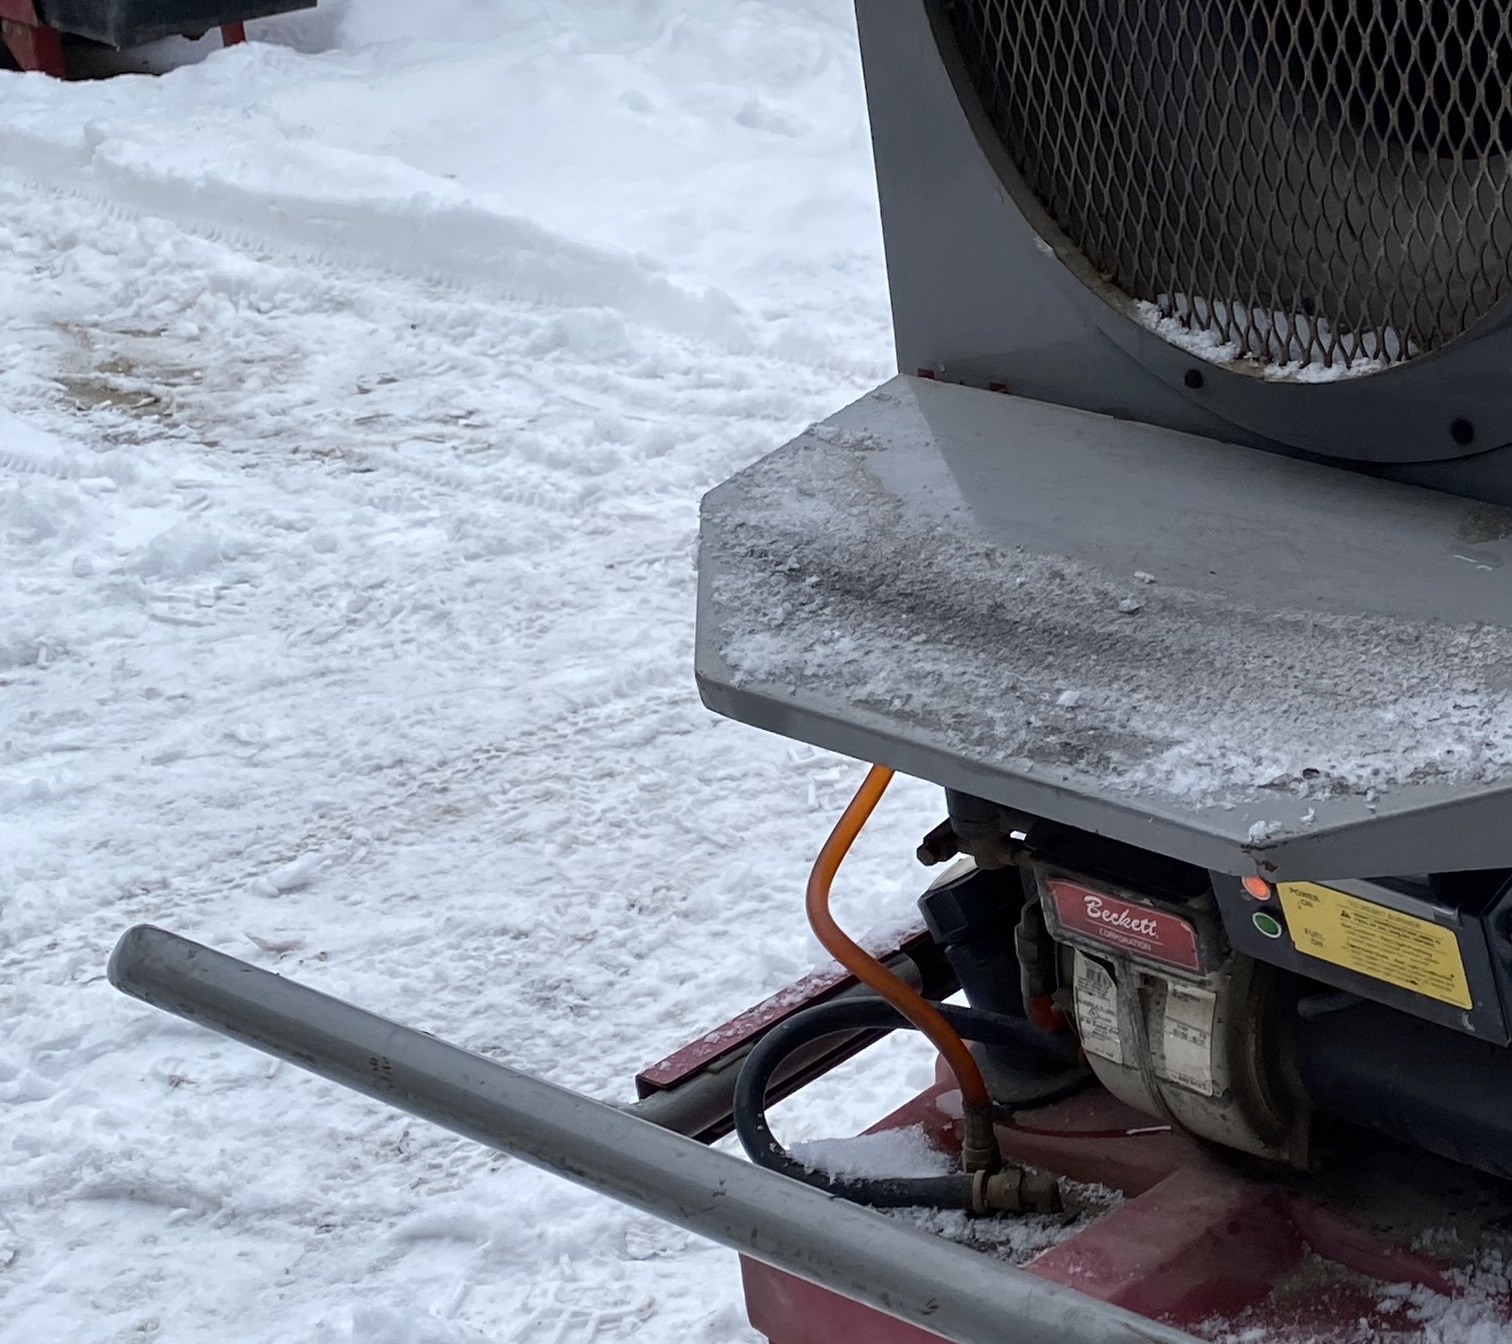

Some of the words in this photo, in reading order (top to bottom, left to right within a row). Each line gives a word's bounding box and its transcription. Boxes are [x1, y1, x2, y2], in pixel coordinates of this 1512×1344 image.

[1289, 887, 1320, 902] POWER
[1084, 896, 1157, 936] Beckett
[1099, 927, 1151, 951] CORPORATION
